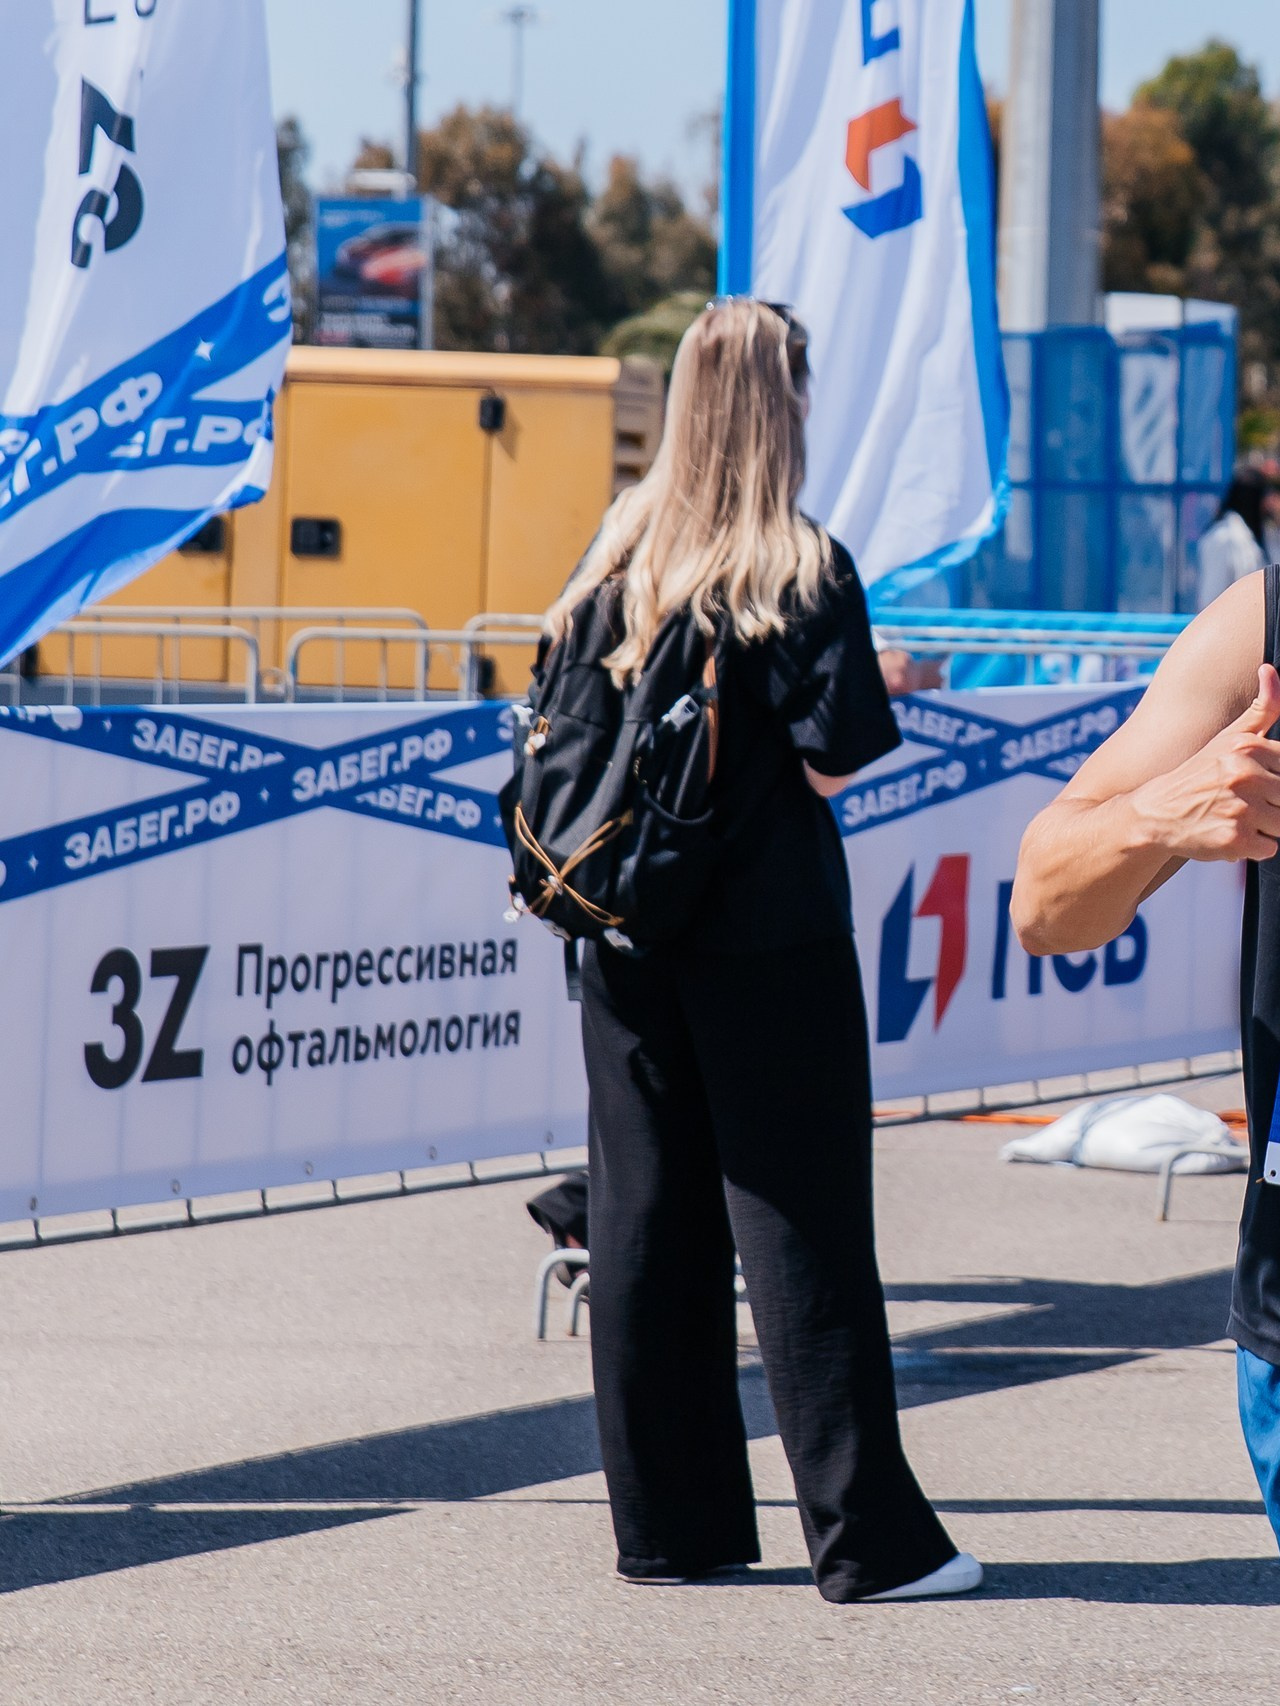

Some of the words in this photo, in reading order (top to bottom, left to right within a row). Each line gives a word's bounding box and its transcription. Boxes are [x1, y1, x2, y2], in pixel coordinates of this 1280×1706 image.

[291, 728, 453, 802] ЗАБЕГ.РФ
[842, 760, 967, 828] ЗАБЕГ.РФ
[64, 790, 241, 870] ЗАБЕГ.РФ
[235, 938, 518, 1008] Прогрессивная
[83, 944, 210, 1089] 3Z
[231, 1010, 521, 1086] офтальмология
